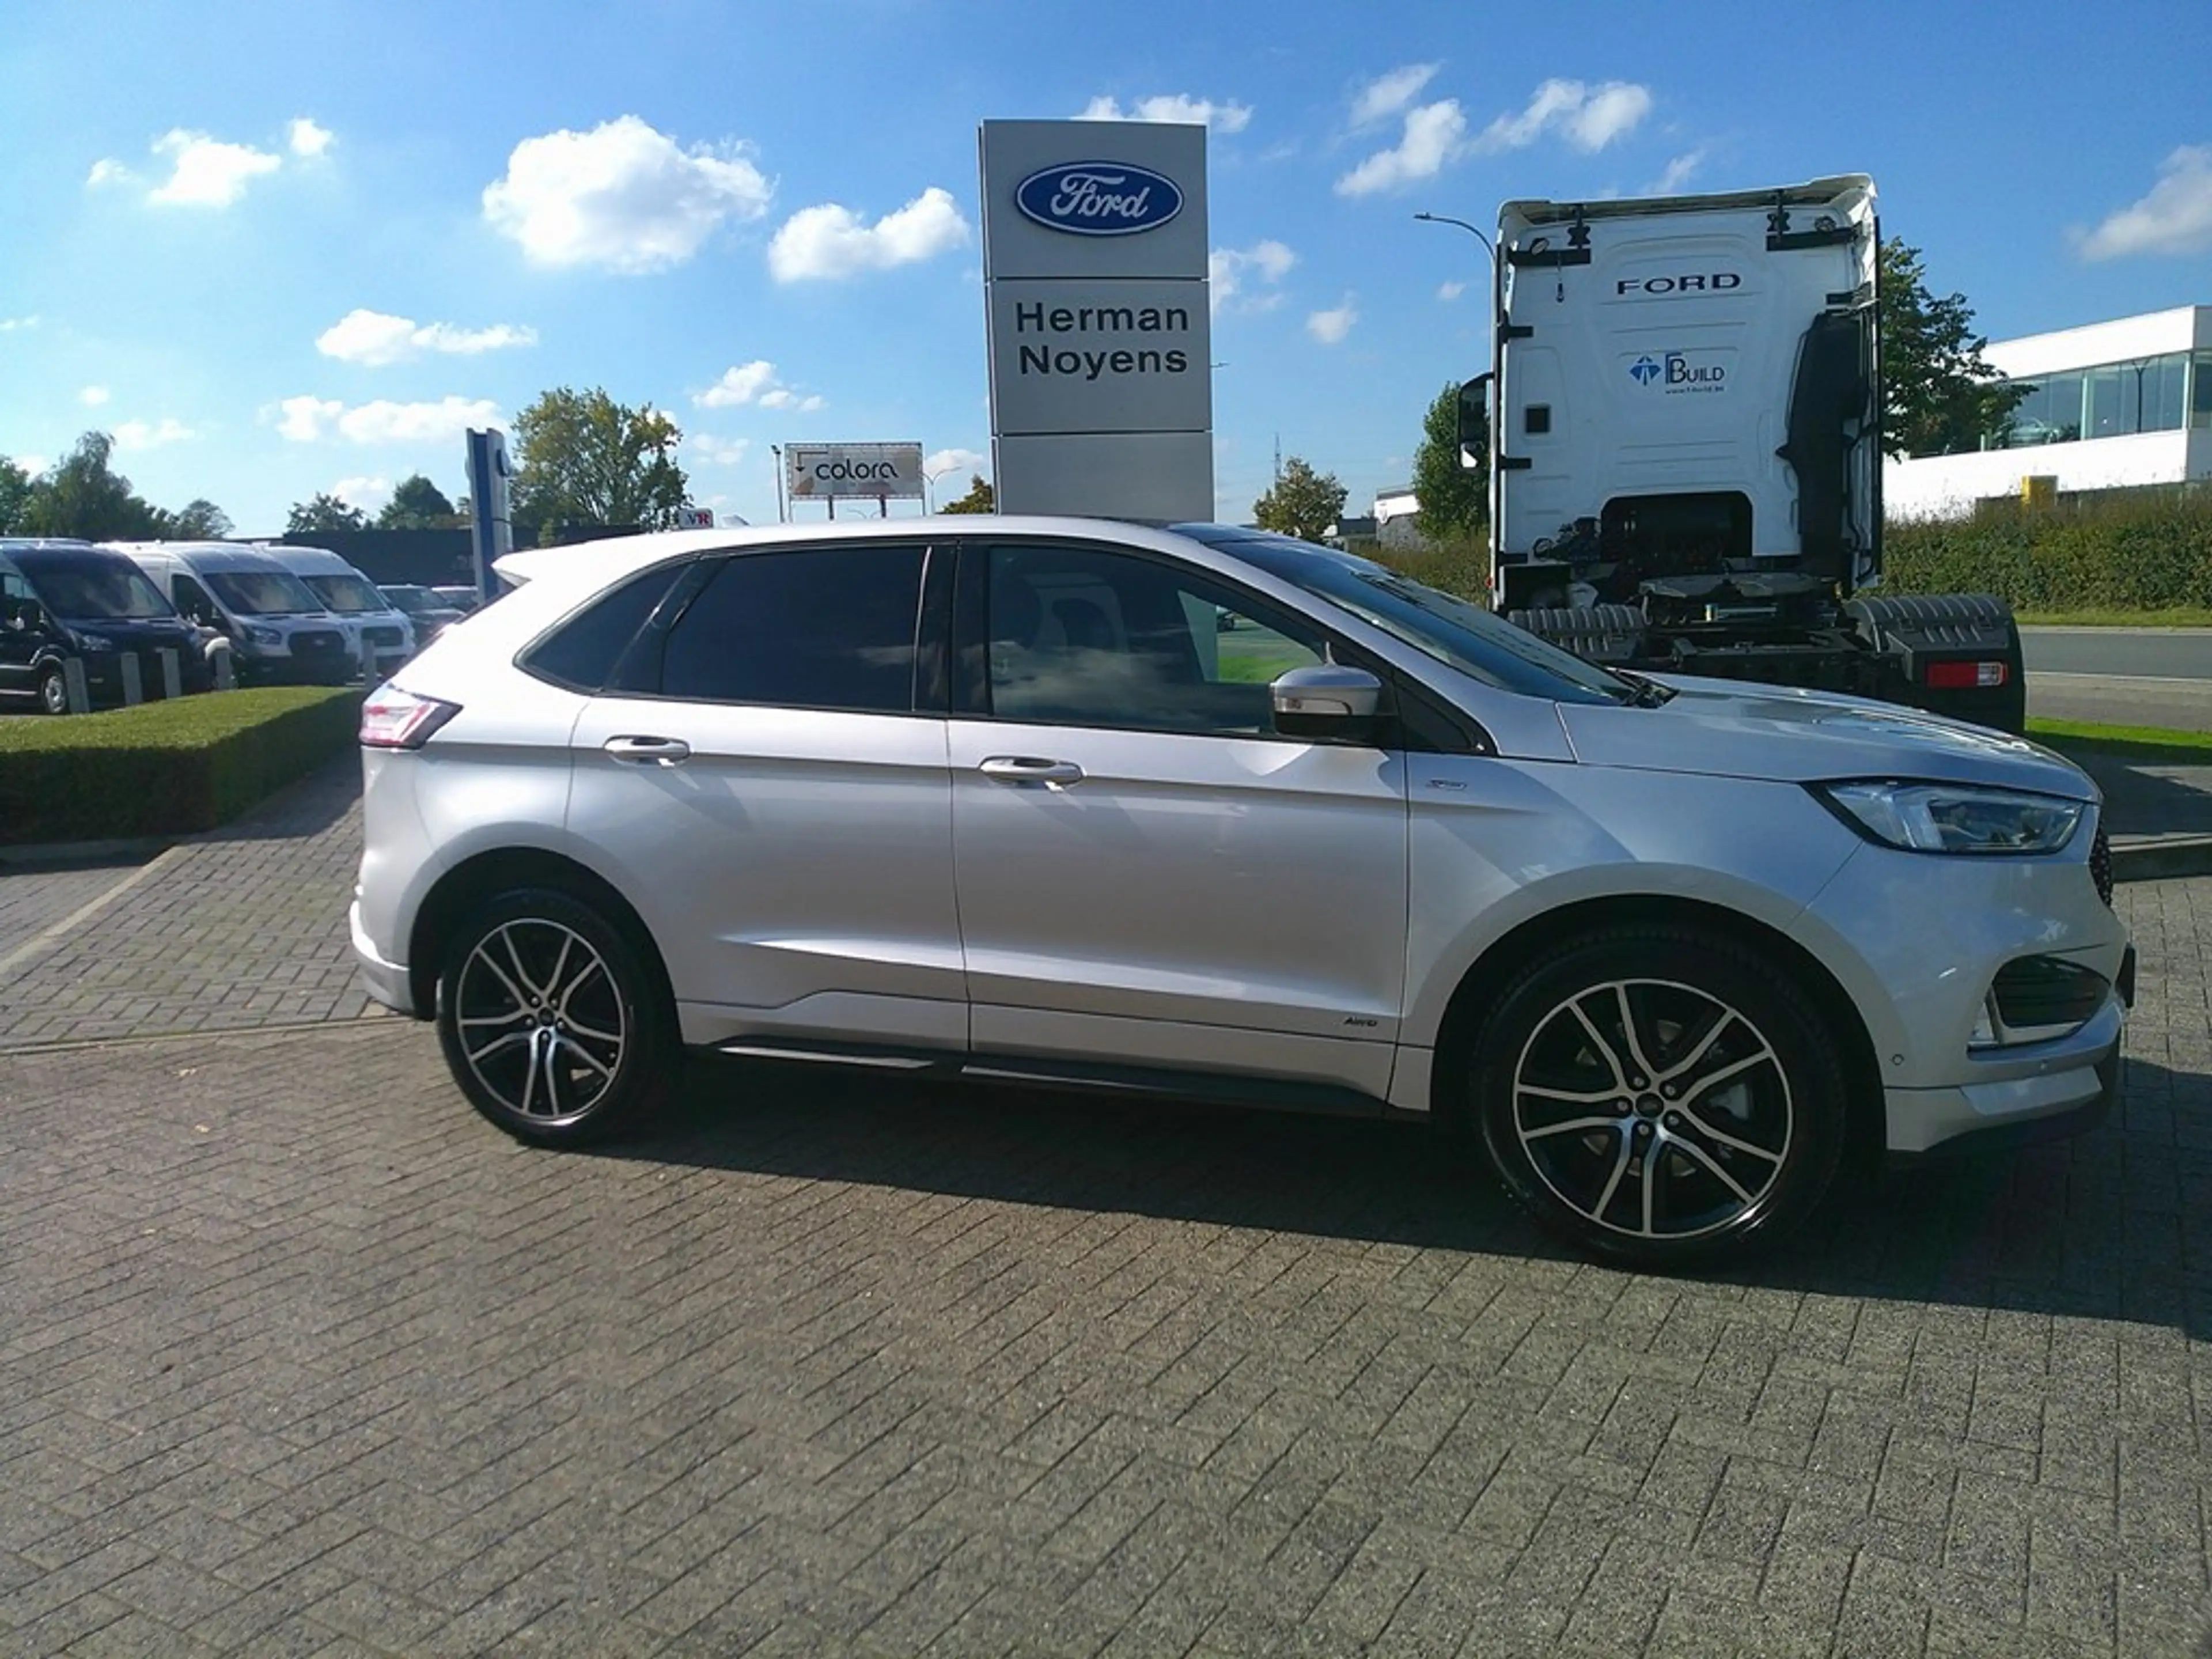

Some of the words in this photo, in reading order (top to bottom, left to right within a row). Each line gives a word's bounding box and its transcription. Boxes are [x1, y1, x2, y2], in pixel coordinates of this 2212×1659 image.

[1050, 173, 1150, 218] Ford
[1617, 273, 1741, 295] FORD
[1016, 302, 1189, 333] Herman
[1019, 345, 1188, 381] Noyens
[816, 458, 900, 480] colora
